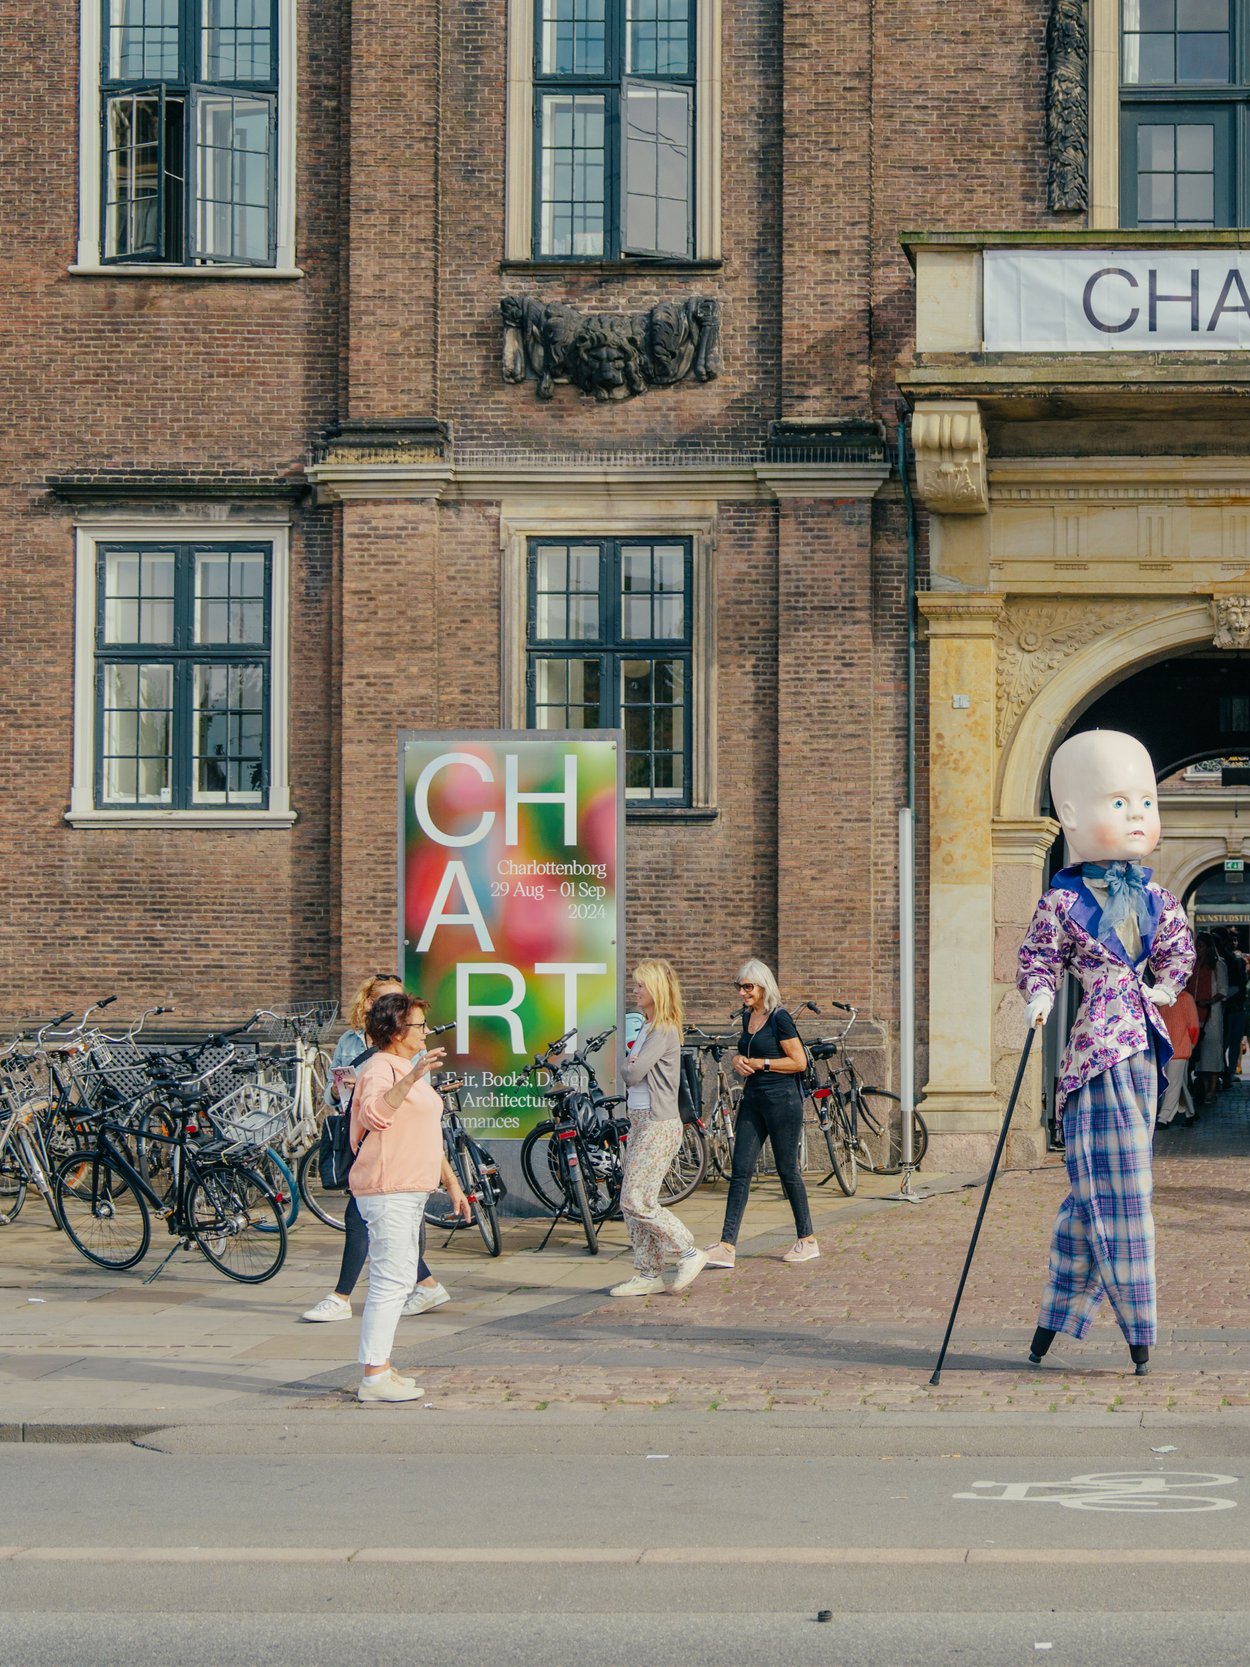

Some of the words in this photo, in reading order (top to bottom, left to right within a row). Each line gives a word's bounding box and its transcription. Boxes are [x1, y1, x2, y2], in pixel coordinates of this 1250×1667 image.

[497, 859, 607, 879] Charlottenborg
[490, 881, 510, 897] 29
[513, 881, 545, 900] Aug
[560, 881, 575, 897] 01
[578, 881, 606, 900] Sep
[568, 903, 607, 919] 2024
[446, 1071, 478, 1089] Fir,
